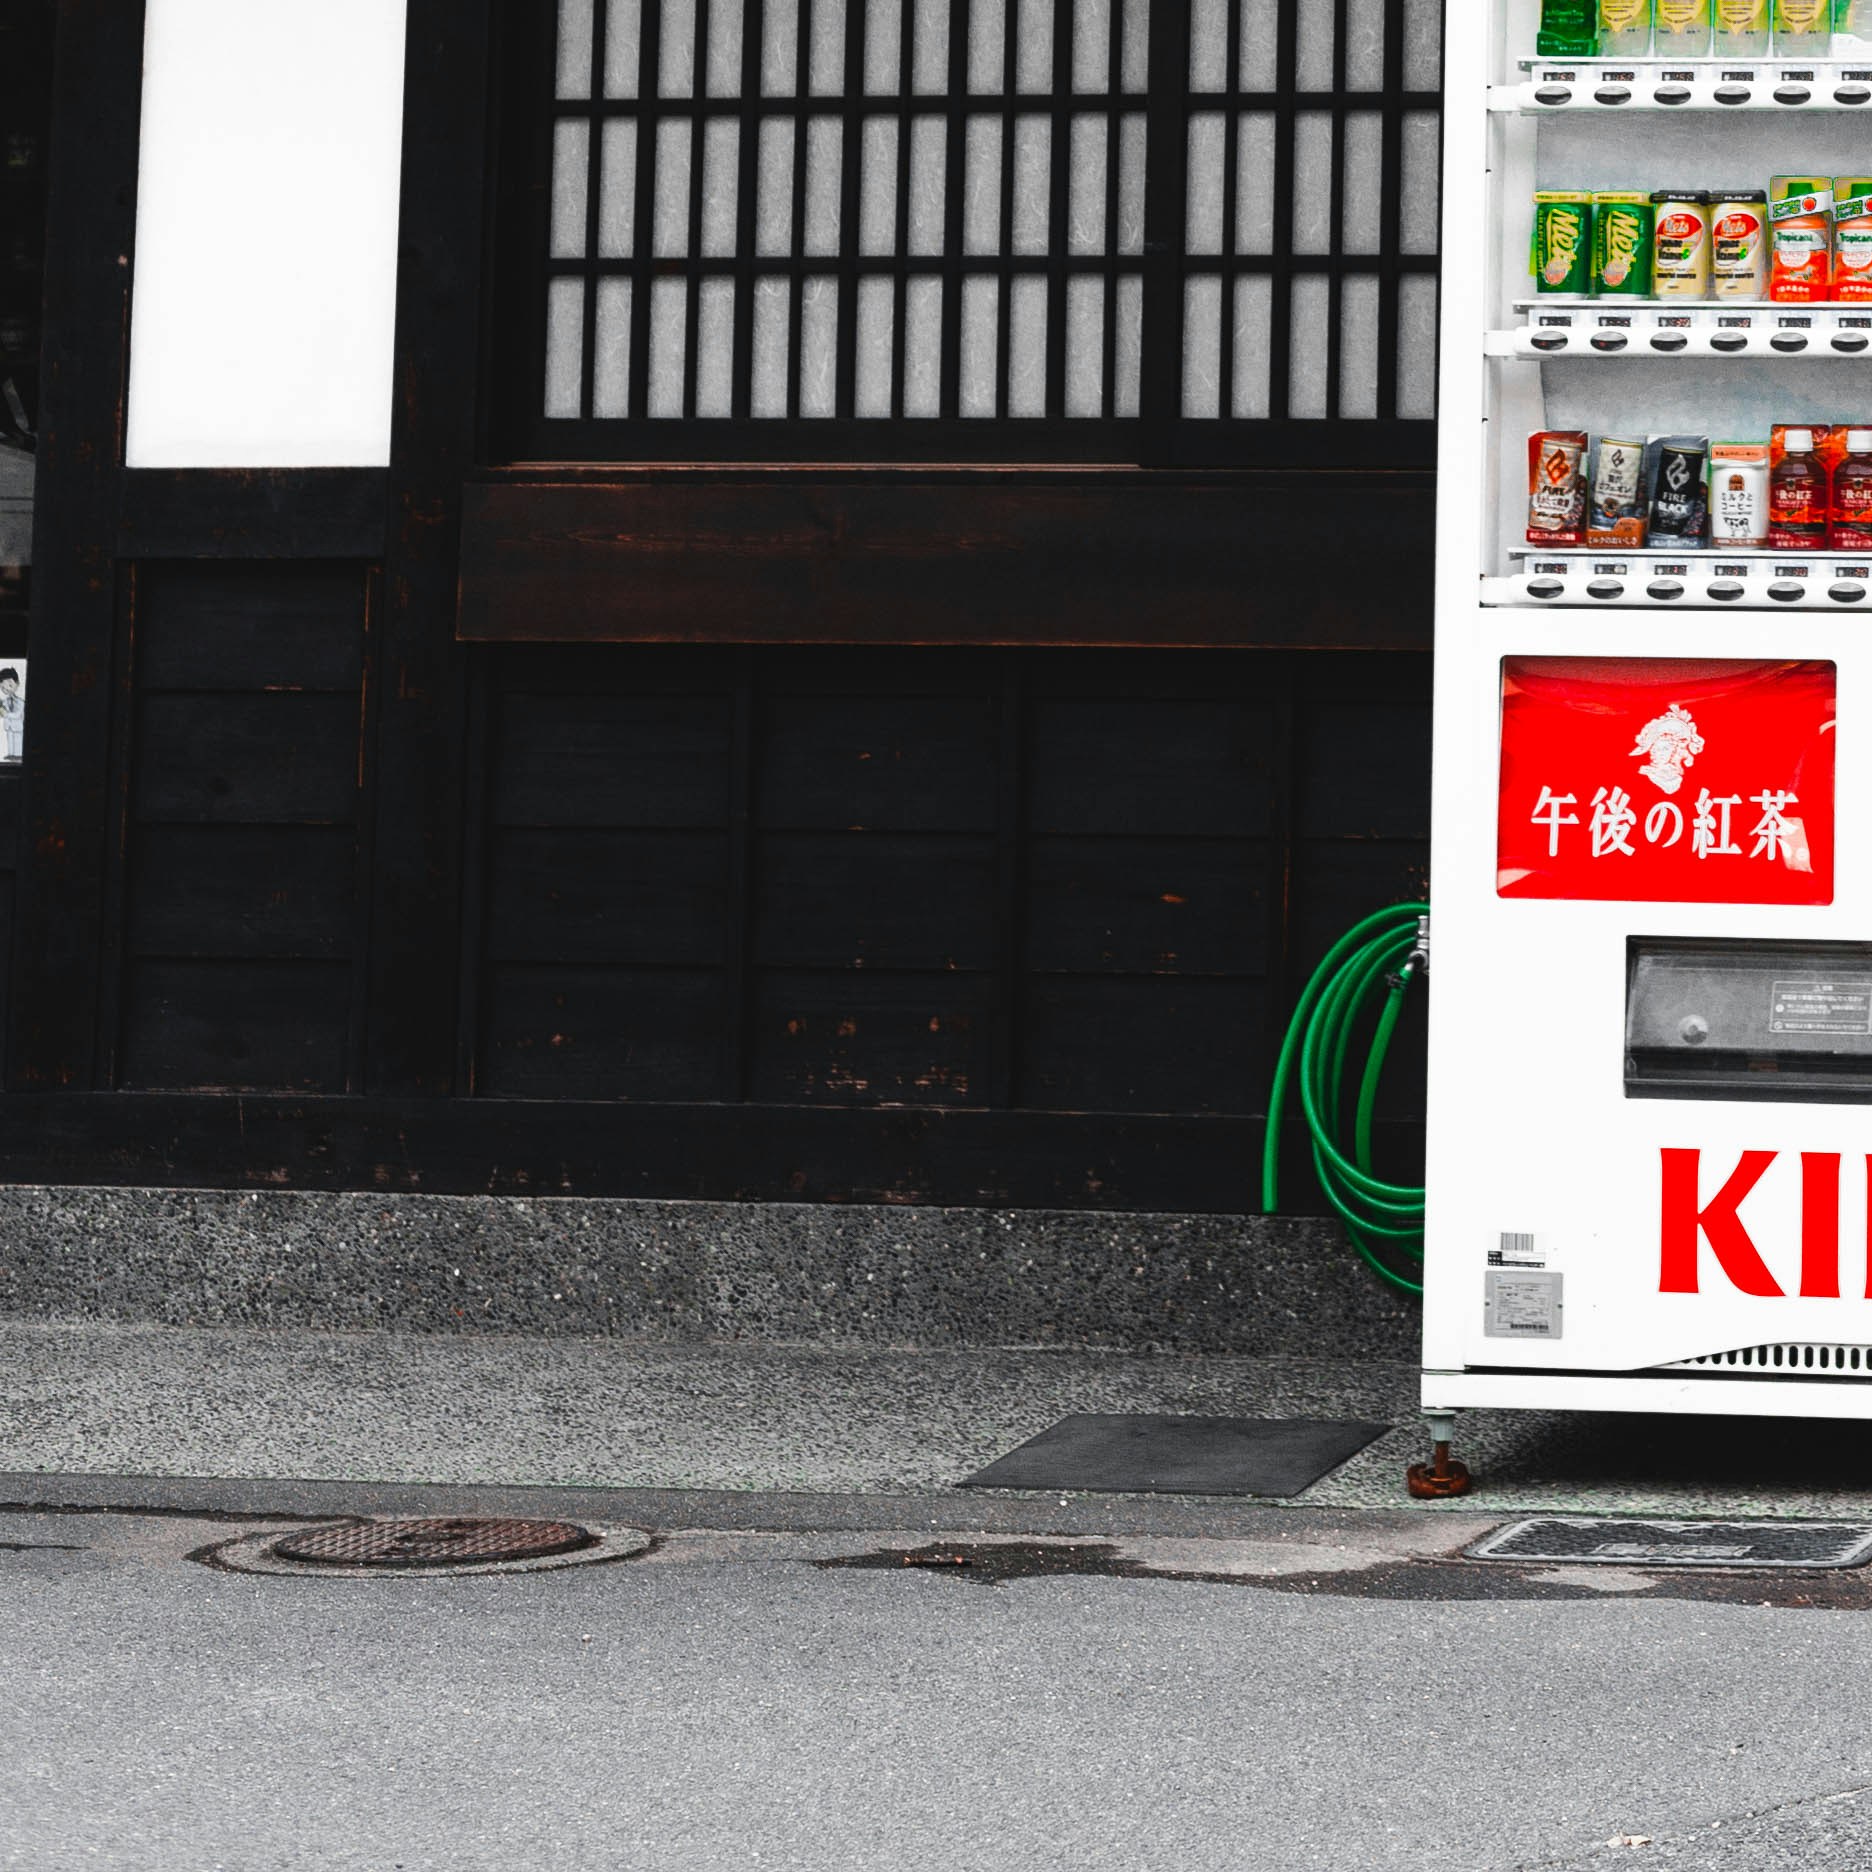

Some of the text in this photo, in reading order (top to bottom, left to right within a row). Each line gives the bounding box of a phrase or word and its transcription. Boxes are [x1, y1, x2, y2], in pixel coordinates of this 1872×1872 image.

[1663, 491, 1687, 503] FIRE
[1721, 492, 1753, 502] ミルクと
[1721, 502, 1753, 510] コーヒー
[1530, 786, 1800, 860] 午後の紅茶
